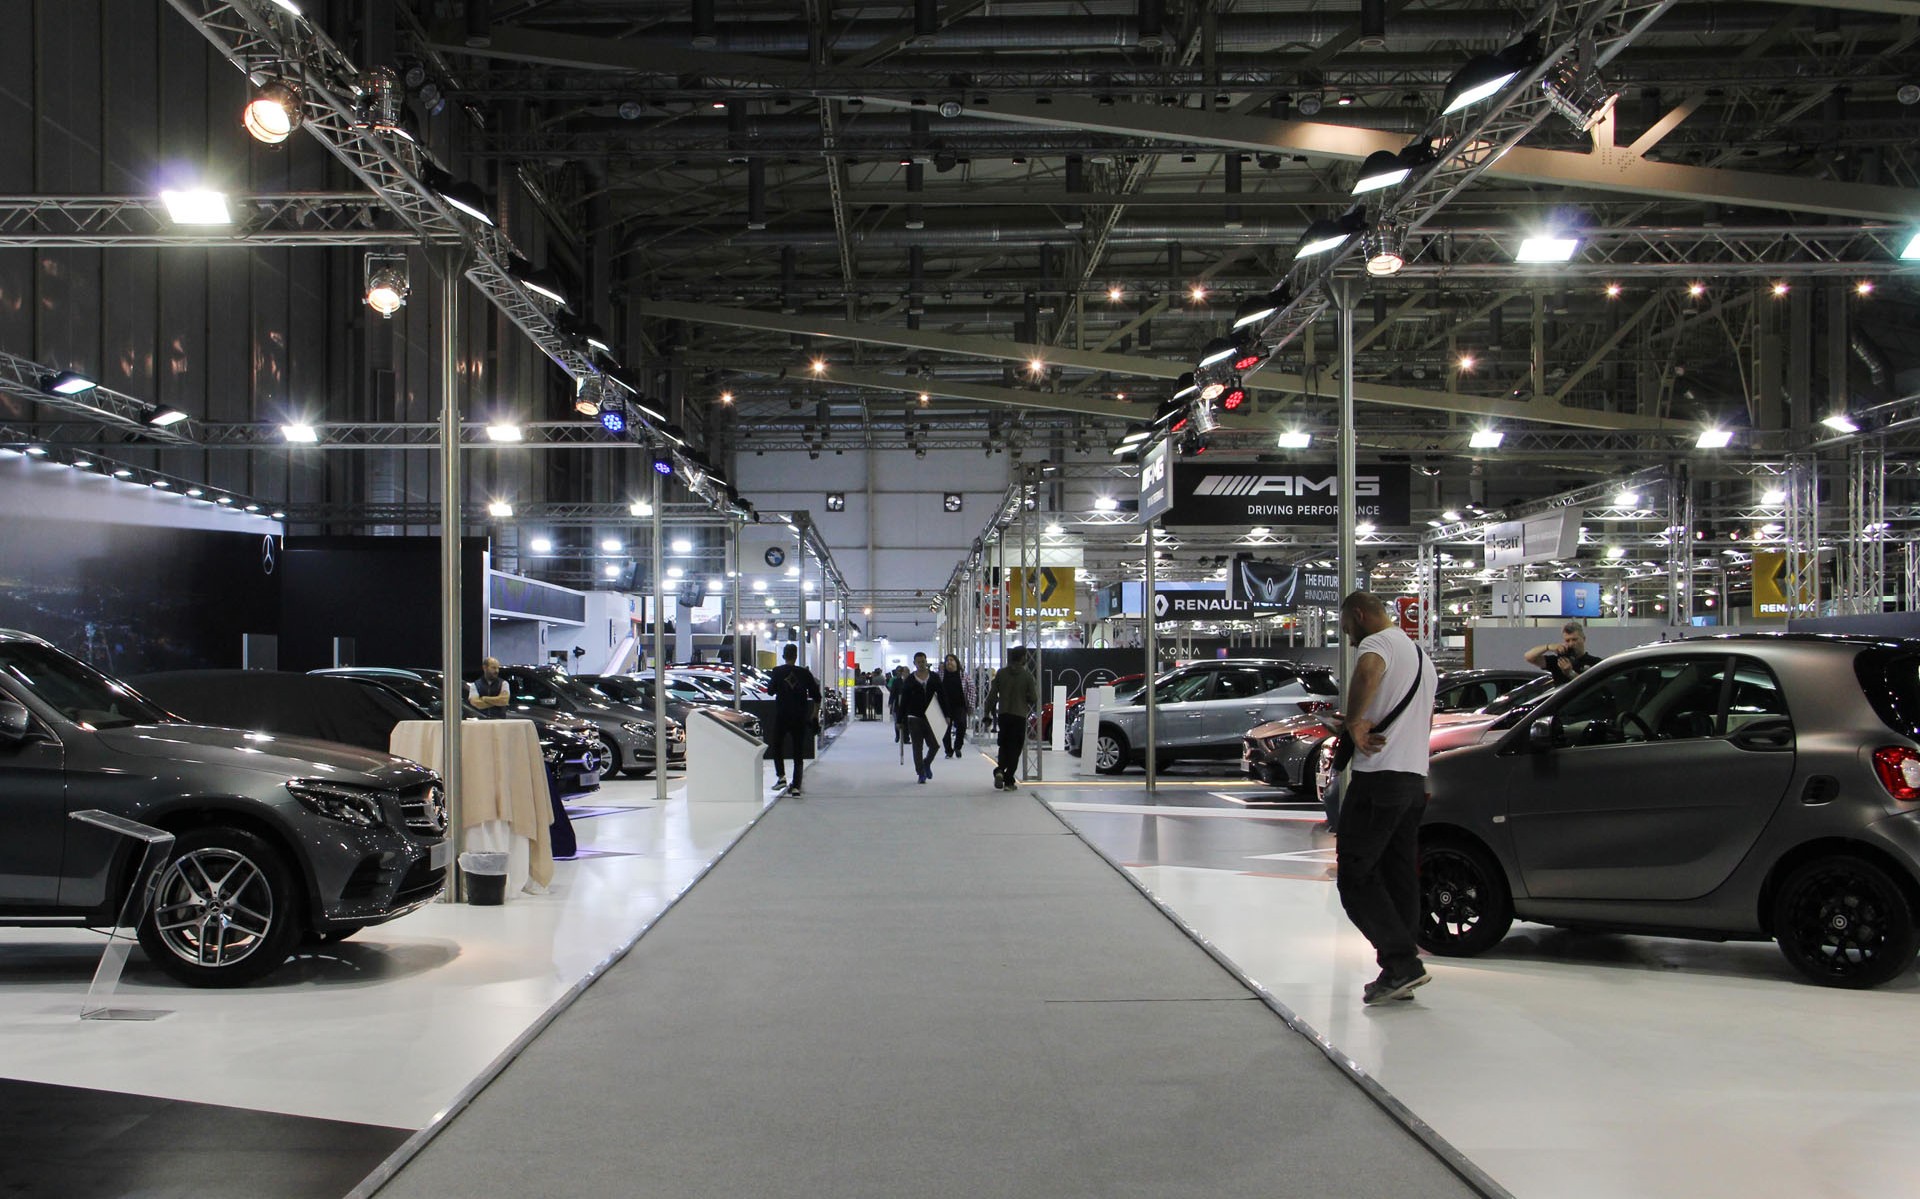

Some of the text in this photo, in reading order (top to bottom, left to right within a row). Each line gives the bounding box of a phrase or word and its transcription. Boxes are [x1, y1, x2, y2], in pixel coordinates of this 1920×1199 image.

[1249, 475, 1380, 496] AMG
[1247, 505, 1380, 515] DRIVING PERFORNCE
[1305, 574, 1317, 586] THE
[1318, 575, 1340, 588] FUTUR
[1014, 607, 1070, 617] RENAULT
